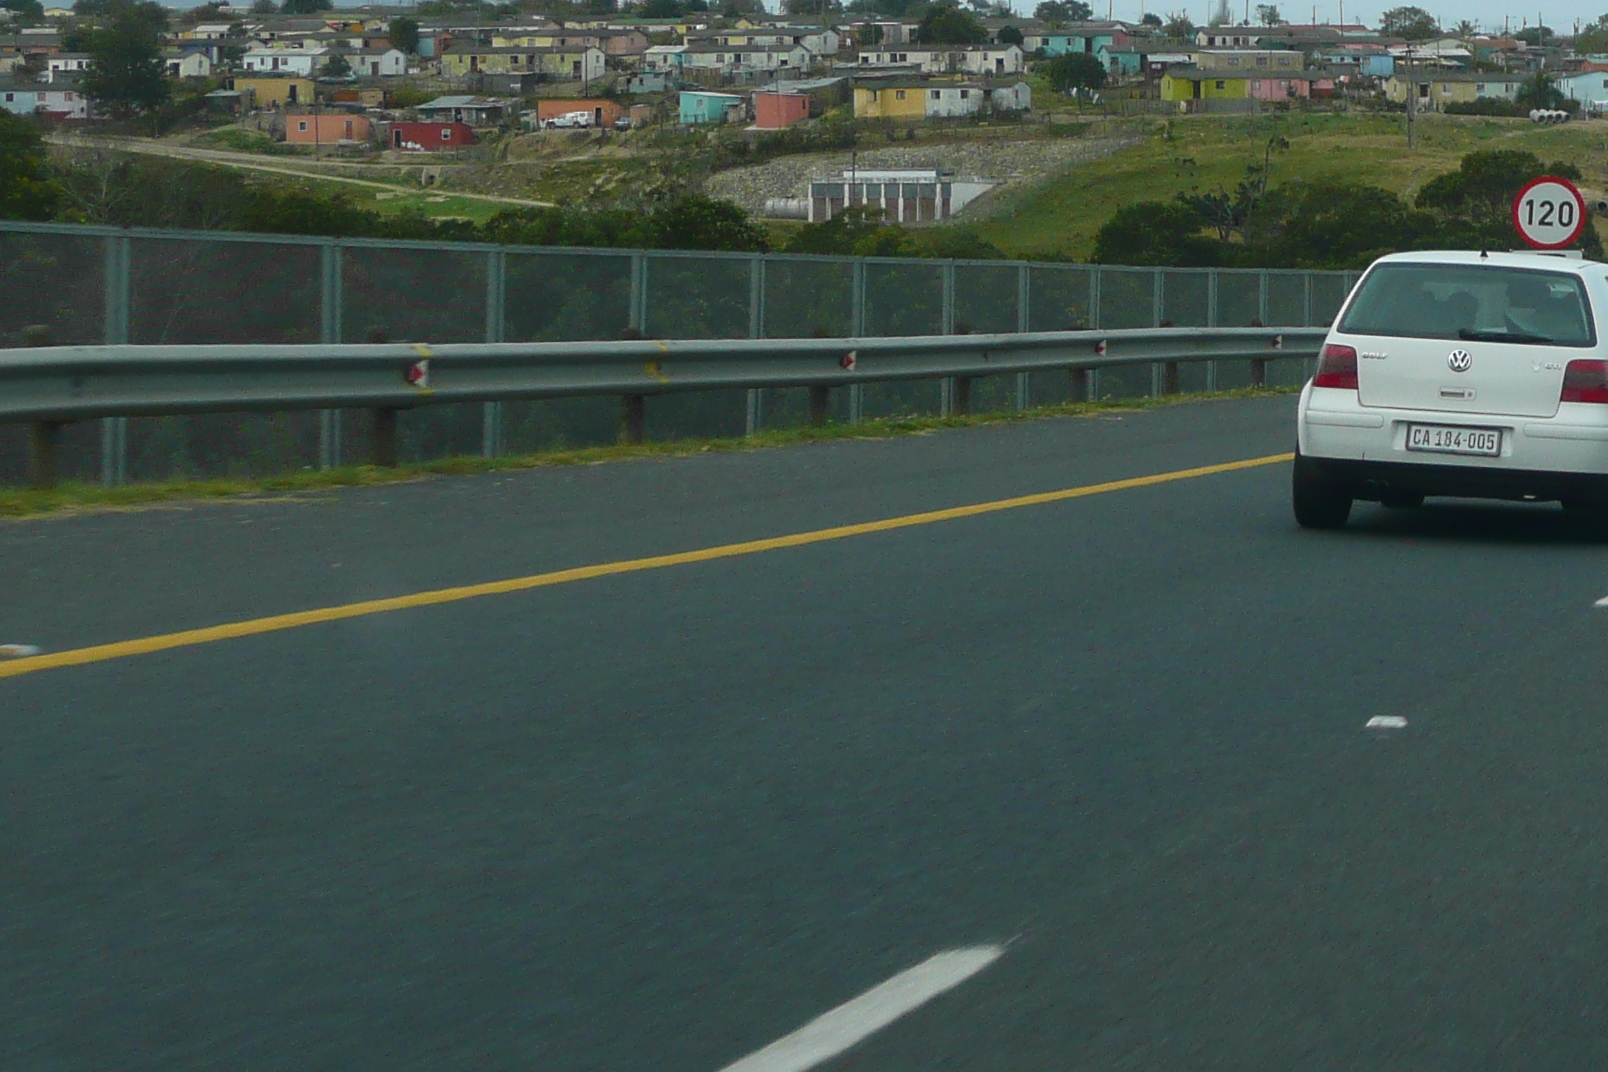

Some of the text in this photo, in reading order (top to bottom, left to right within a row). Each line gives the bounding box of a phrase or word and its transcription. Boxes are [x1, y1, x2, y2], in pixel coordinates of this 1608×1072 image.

[1525, 199, 1573, 227] 120
[1413, 429, 1495, 450] CA 184-005
